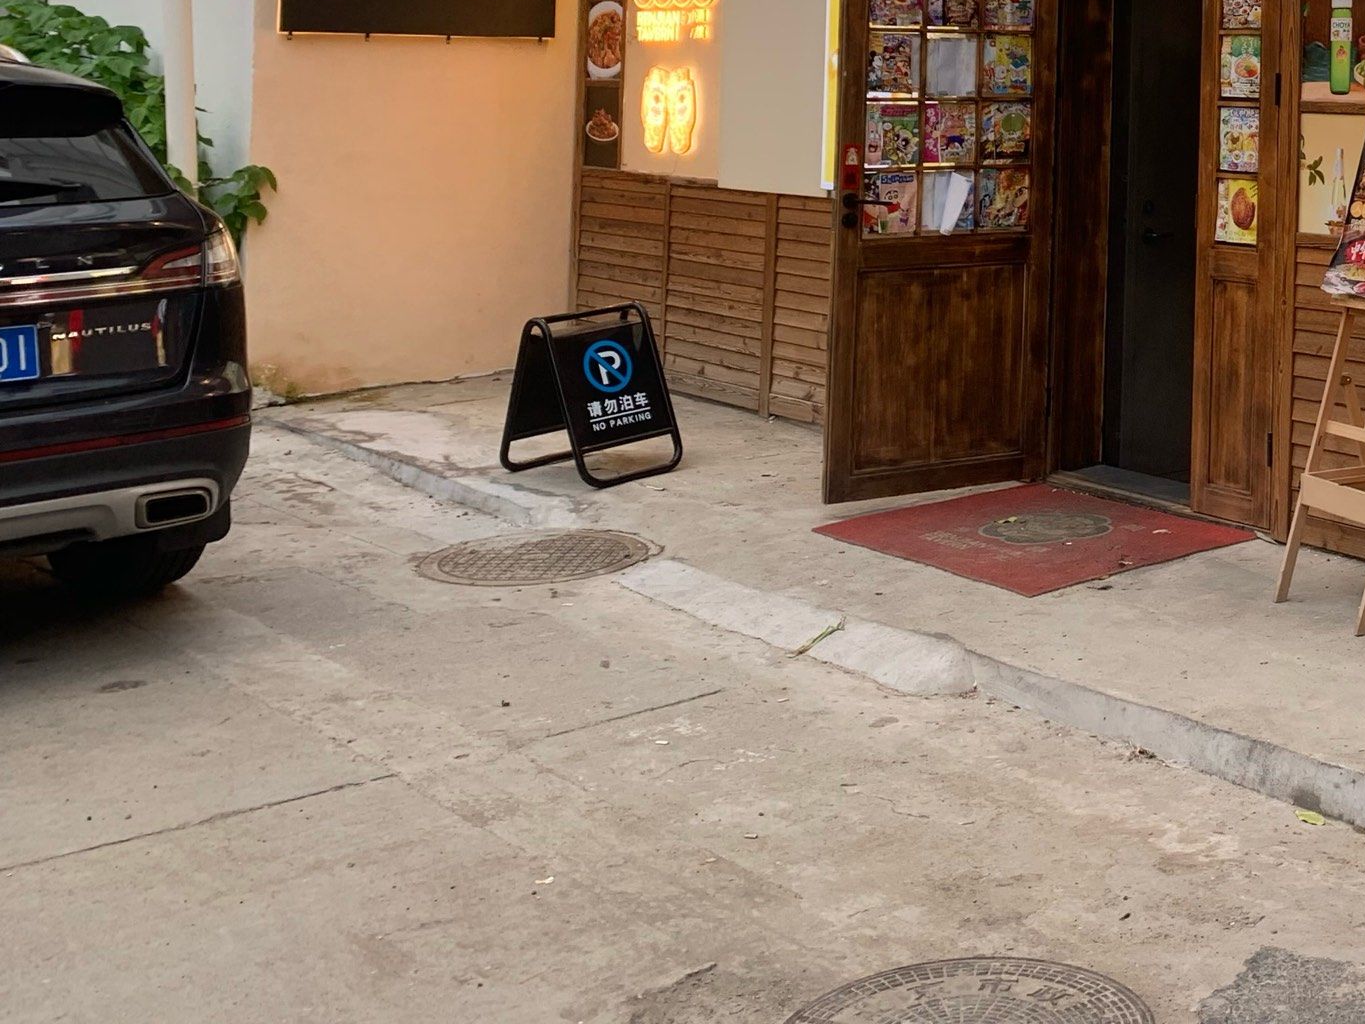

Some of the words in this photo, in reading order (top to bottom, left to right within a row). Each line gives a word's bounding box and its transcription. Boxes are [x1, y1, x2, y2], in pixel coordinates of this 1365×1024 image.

[1332, 21, 1350, 29] CHOYA
[52, 322, 151, 340] NAUTILUS
[587, 392, 649, 417] 请勿泊车
[592, 422, 606, 432] NO
[610, 411, 652, 428] PARKING
